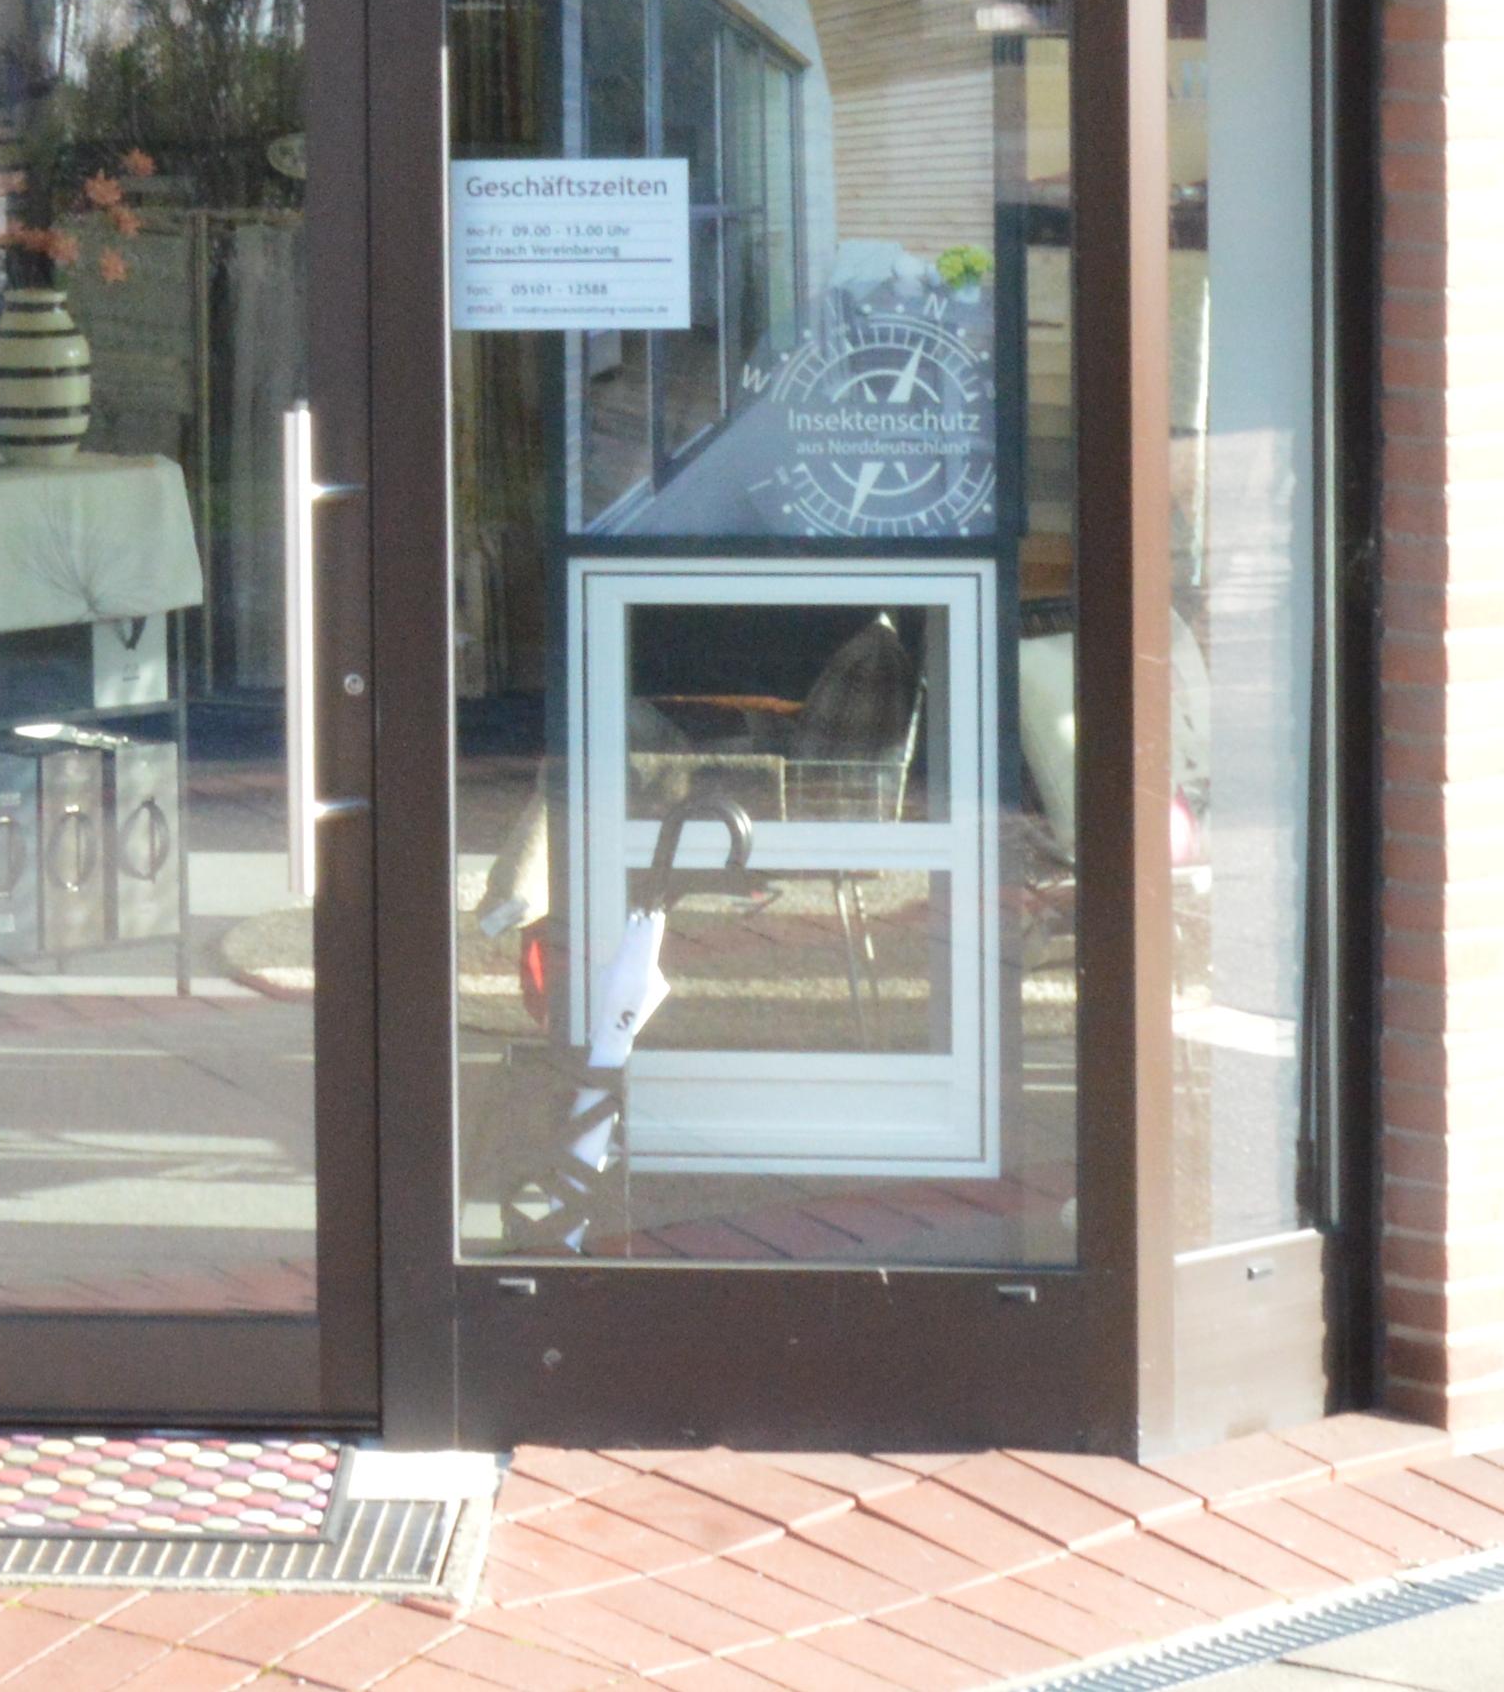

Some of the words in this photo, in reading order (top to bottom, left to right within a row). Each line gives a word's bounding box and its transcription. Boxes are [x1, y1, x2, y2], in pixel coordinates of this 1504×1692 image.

[466, 174, 669, 198] Geschäftszeiten
[607, 224, 631, 238] Uhr
[465, 244, 492, 257] und
[495, 243, 527, 256] nach
[531, 242, 621, 258] Vereinbarung
[788, 408, 981, 433] Insektenschutz
[795, 441, 825, 456] aus
[827, 438, 972, 456] Norddeutschland
